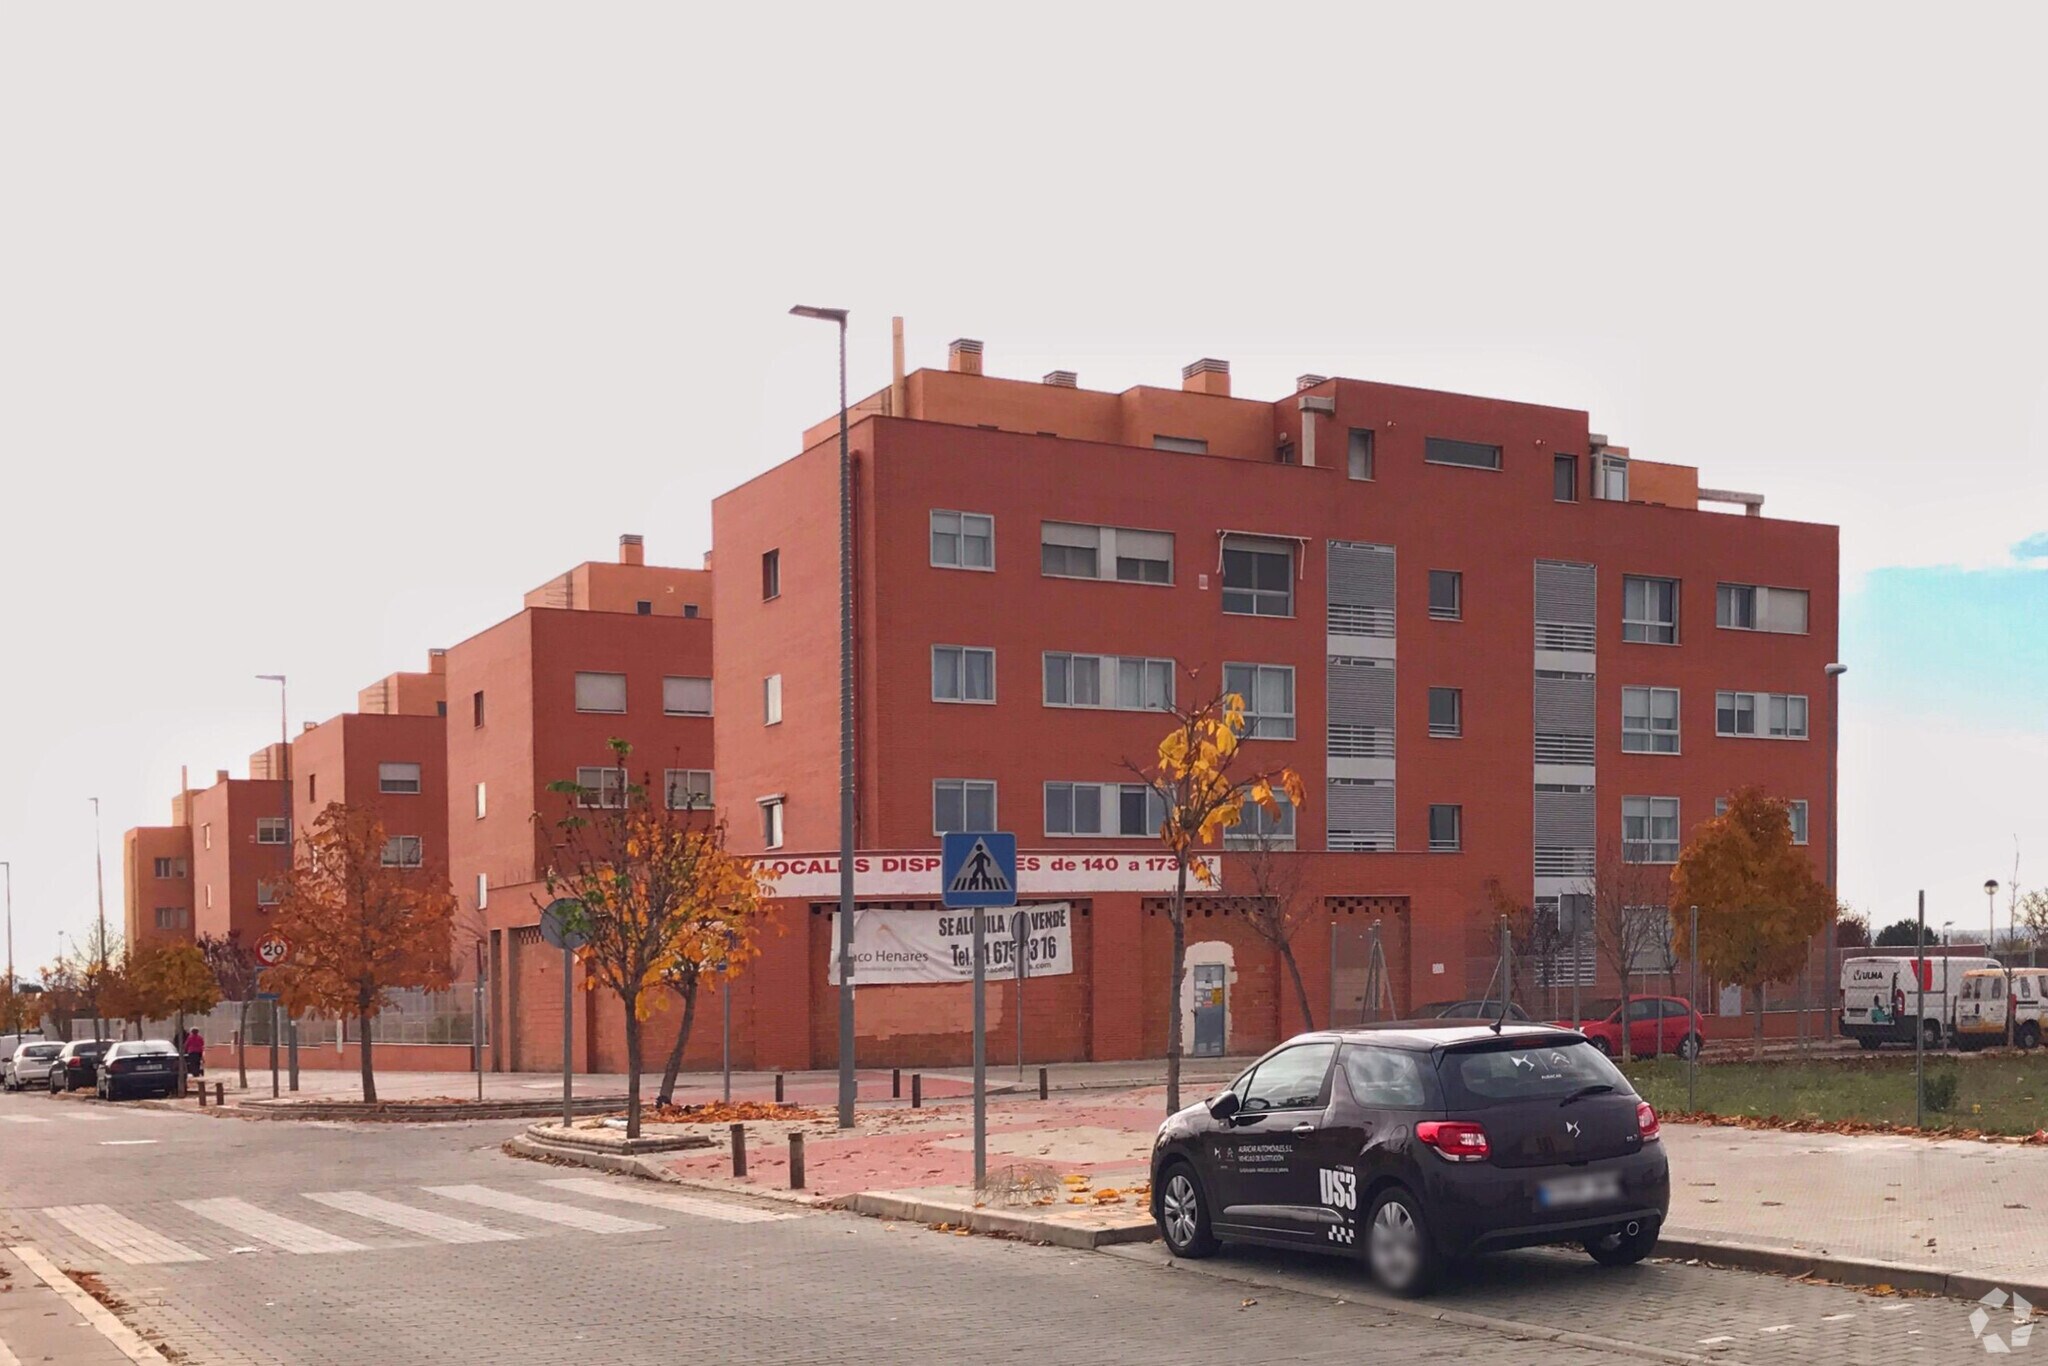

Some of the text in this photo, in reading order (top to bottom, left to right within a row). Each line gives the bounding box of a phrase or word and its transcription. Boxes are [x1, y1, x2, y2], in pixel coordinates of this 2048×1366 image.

[759, 858, 870, 875] OCALS
[882, 857, 1040, 873] DISPES
[1051, 858, 1076, 871] de
[1082, 858, 1119, 871] 140
[1128, 862, 1140, 871] a
[1146, 858, 1179, 871] 173
[956, 914, 1005, 935] ALILA
[1031, 909, 1066, 930] VENDE
[263, 944, 284, 956] 20
[875, 950, 929, 962] Henares
[951, 945, 973, 966] Tel.
[1862, 971, 1883, 980] ULMA
[1319, 1168, 1357, 1210] DS3
